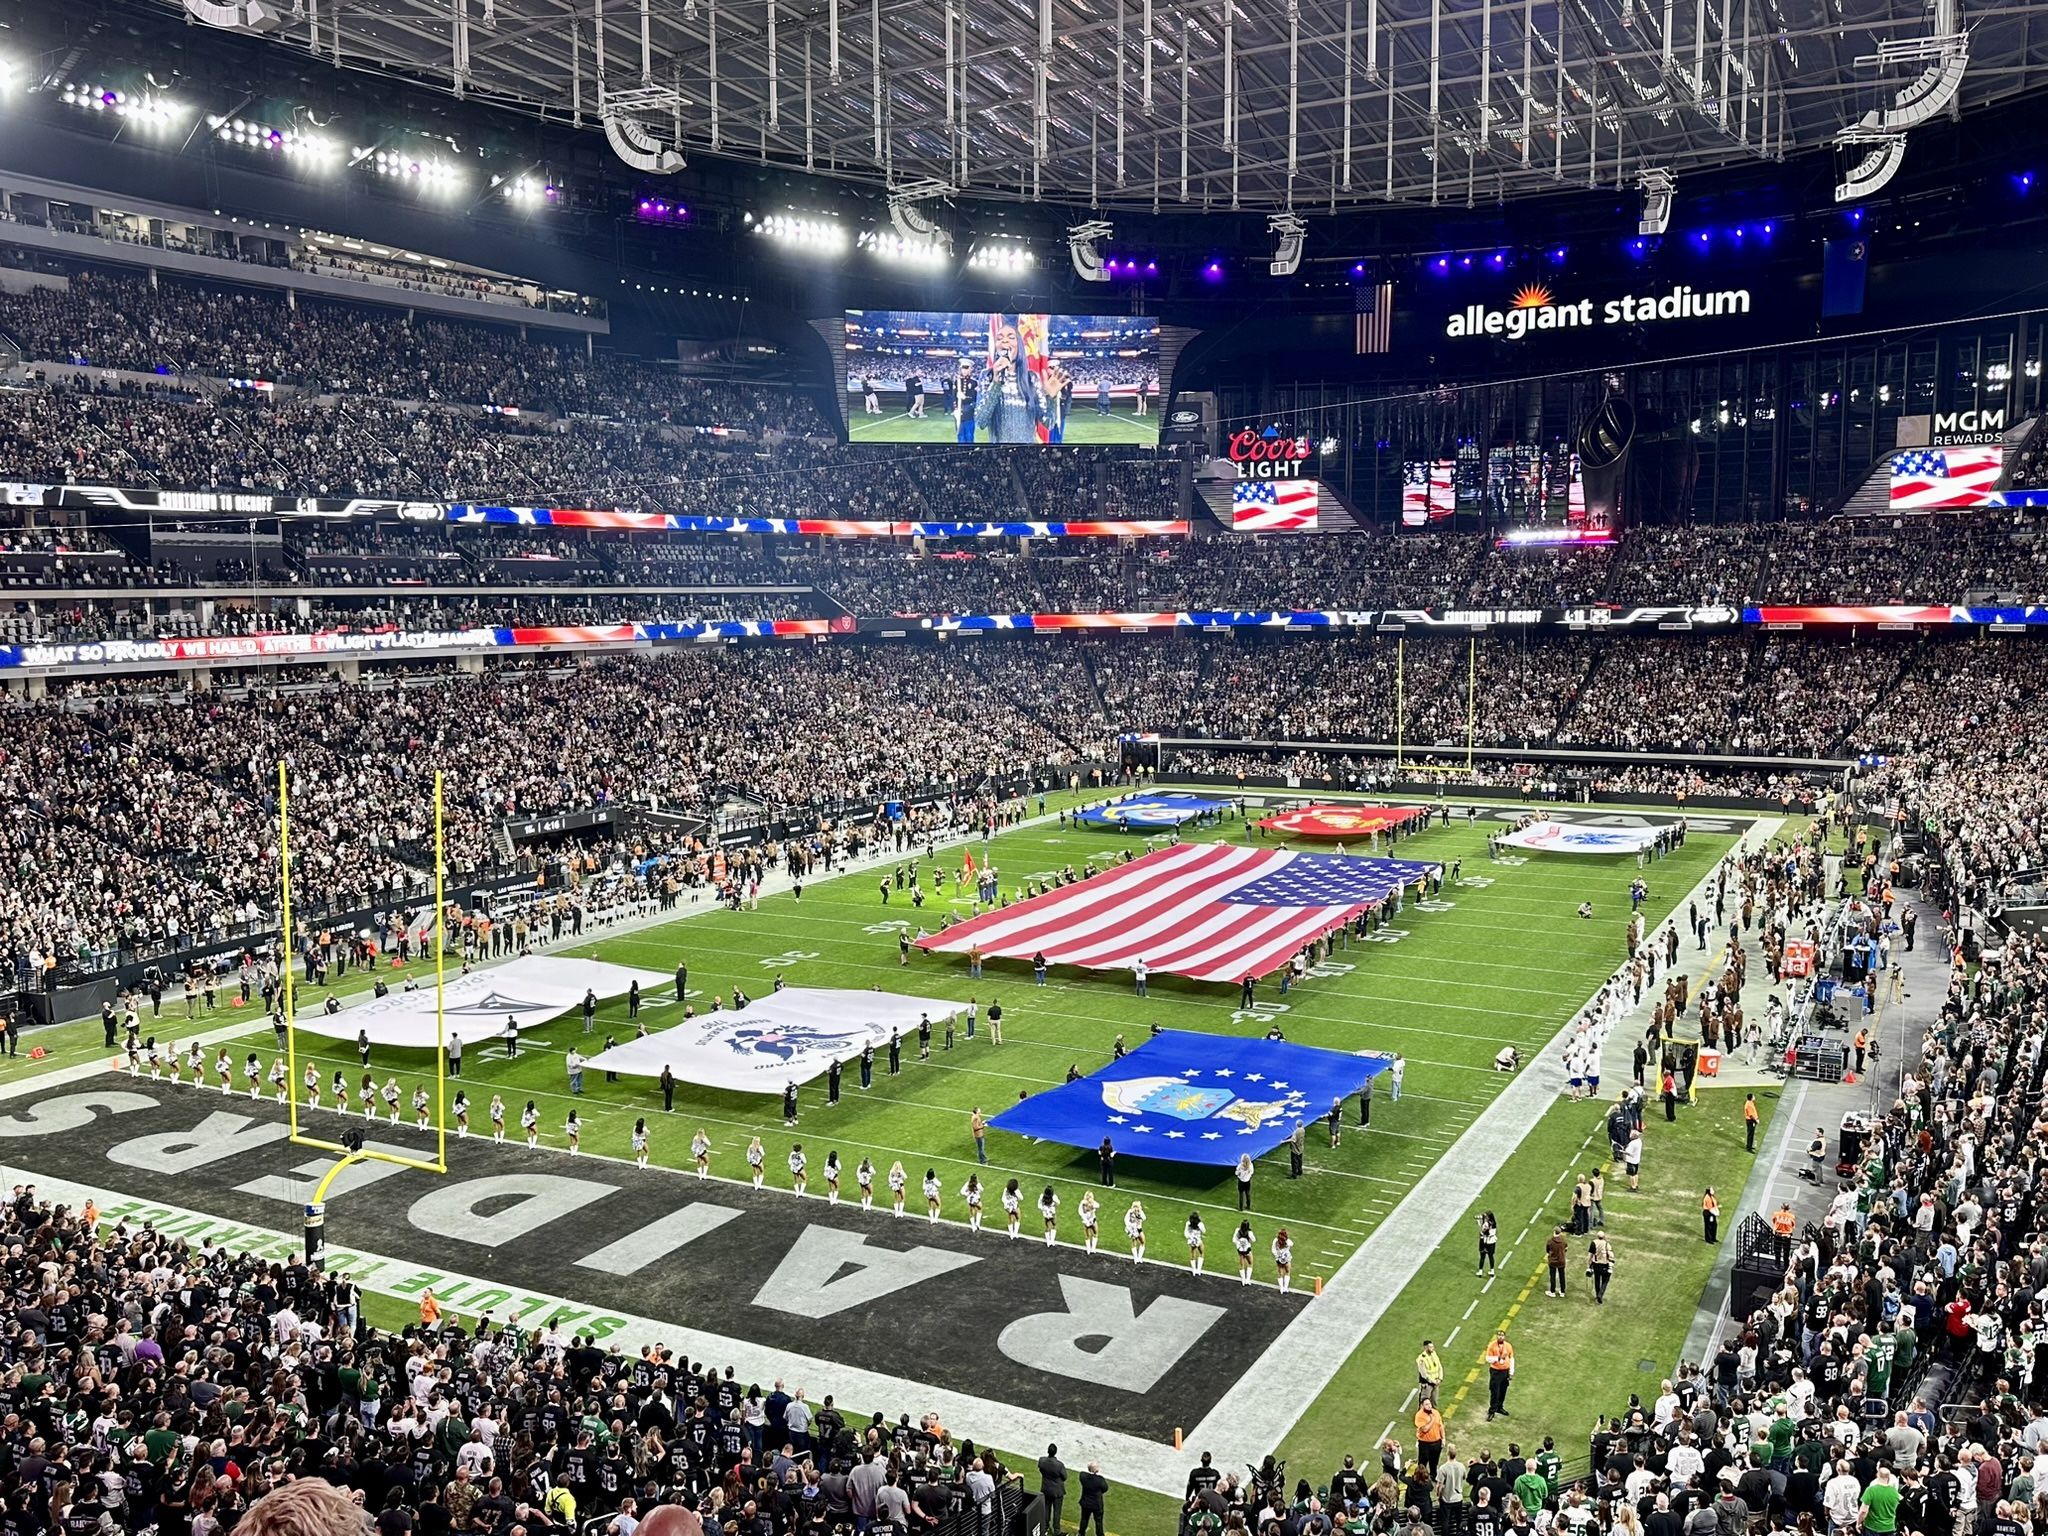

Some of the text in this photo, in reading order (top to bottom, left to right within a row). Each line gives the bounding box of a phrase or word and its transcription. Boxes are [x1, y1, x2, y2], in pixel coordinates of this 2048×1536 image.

[1446, 286, 1750, 339] allegiant stadium
[1934, 409, 2004, 433] MGM
[1229, 430, 1312, 461] Coors
[1934, 432, 2003, 446] REWARDS
[1237, 460, 1303, 478] LIGHT
[158, 491, 217, 511] COUNTDOWN
[219, 494, 233, 511] TO
[234, 495, 273, 513] KICKOFF
[1444, 610, 1493, 623] COUNTDOWN
[1508, 610, 1543, 623] KICKOFF
[24, 645, 76, 664] WHAT
[78, 645, 102, 661] SO
[106, 642, 180, 661] PROUDLY
[183, 641, 207, 656] WE
[759, 951, 820, 966] 30
[1231, 1002, 1291, 1023] 30
[98, 1201, 306, 1261] SERVICE
[0, 1091, 1228, 1394] RAIDERS
[285, 1277, 297, 1290] 13
[389, 1272, 627, 1339] SALUTE
[50, 1316, 67, 1333] 32
[1824, 1367, 1839, 1382] 98
[693, 1429, 707, 1445] 17
[567, 1464, 586, 1483] 24
[1548, 1464, 1557, 1480] 2
